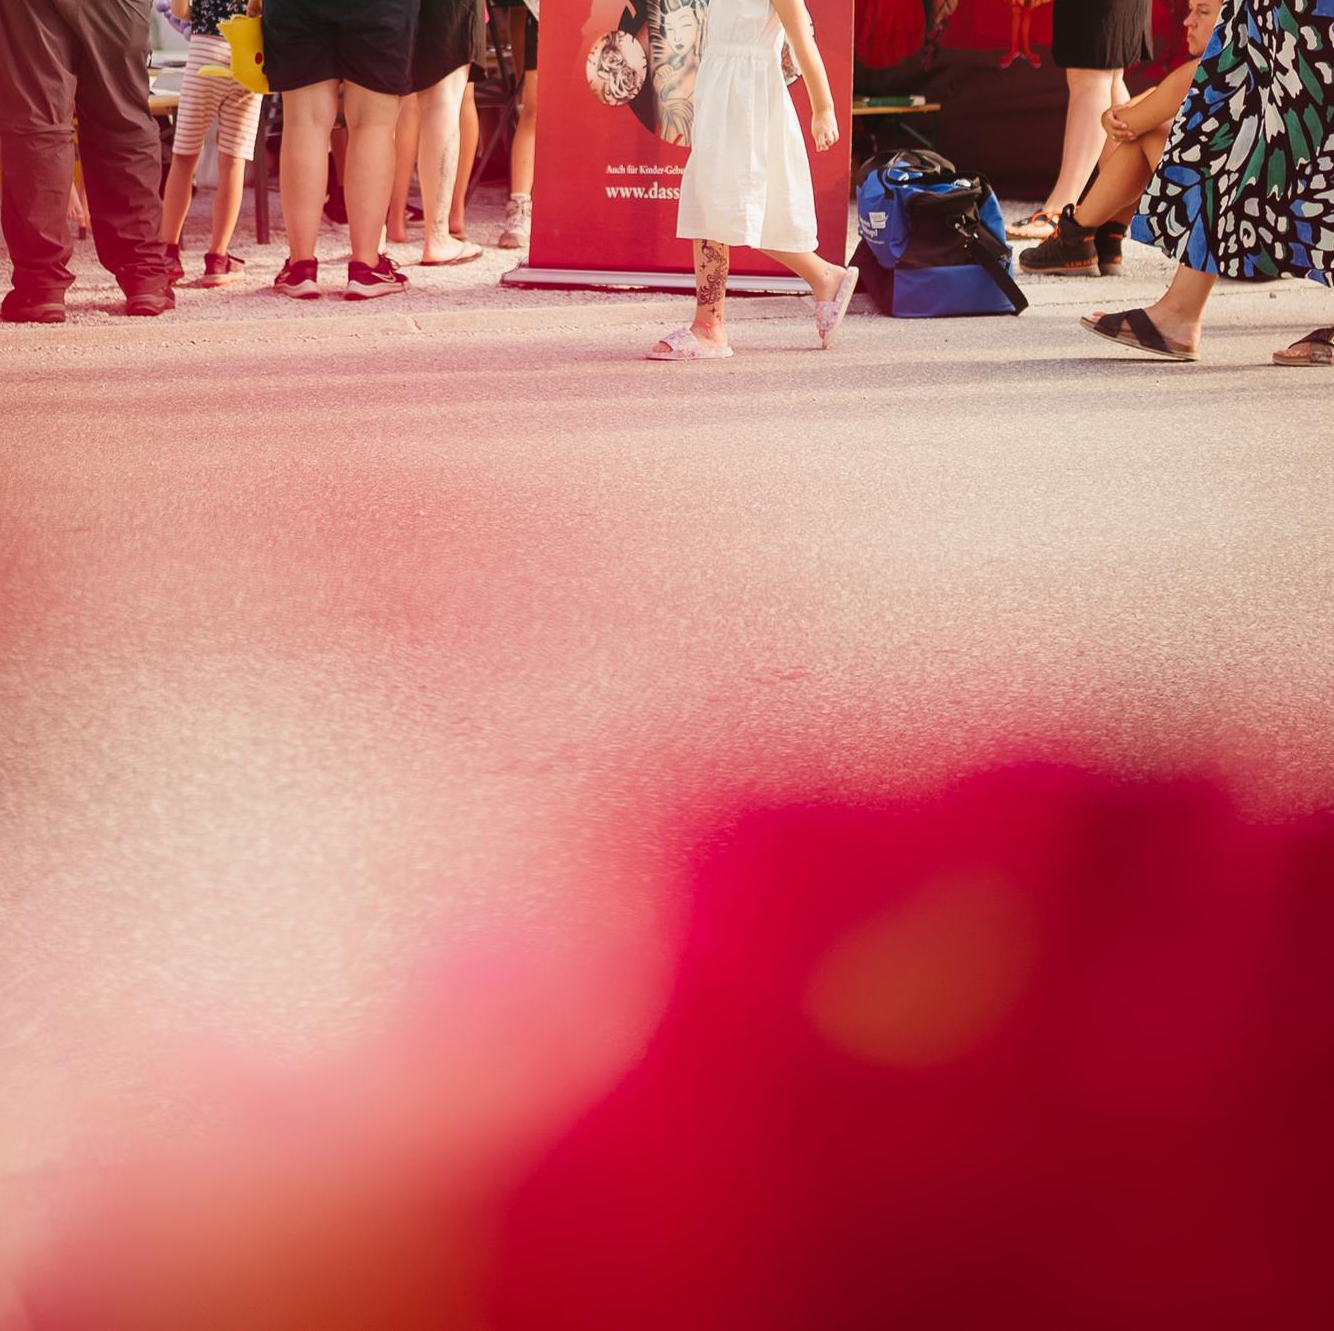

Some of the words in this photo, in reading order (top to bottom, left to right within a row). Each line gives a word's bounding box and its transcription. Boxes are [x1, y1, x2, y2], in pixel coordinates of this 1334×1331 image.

[606, 164, 625, 174] Auch
[627, 164, 638, 174] für
[639, 165, 683, 175] Kinder-Gebu
[605, 181, 680, 199] www.dass
